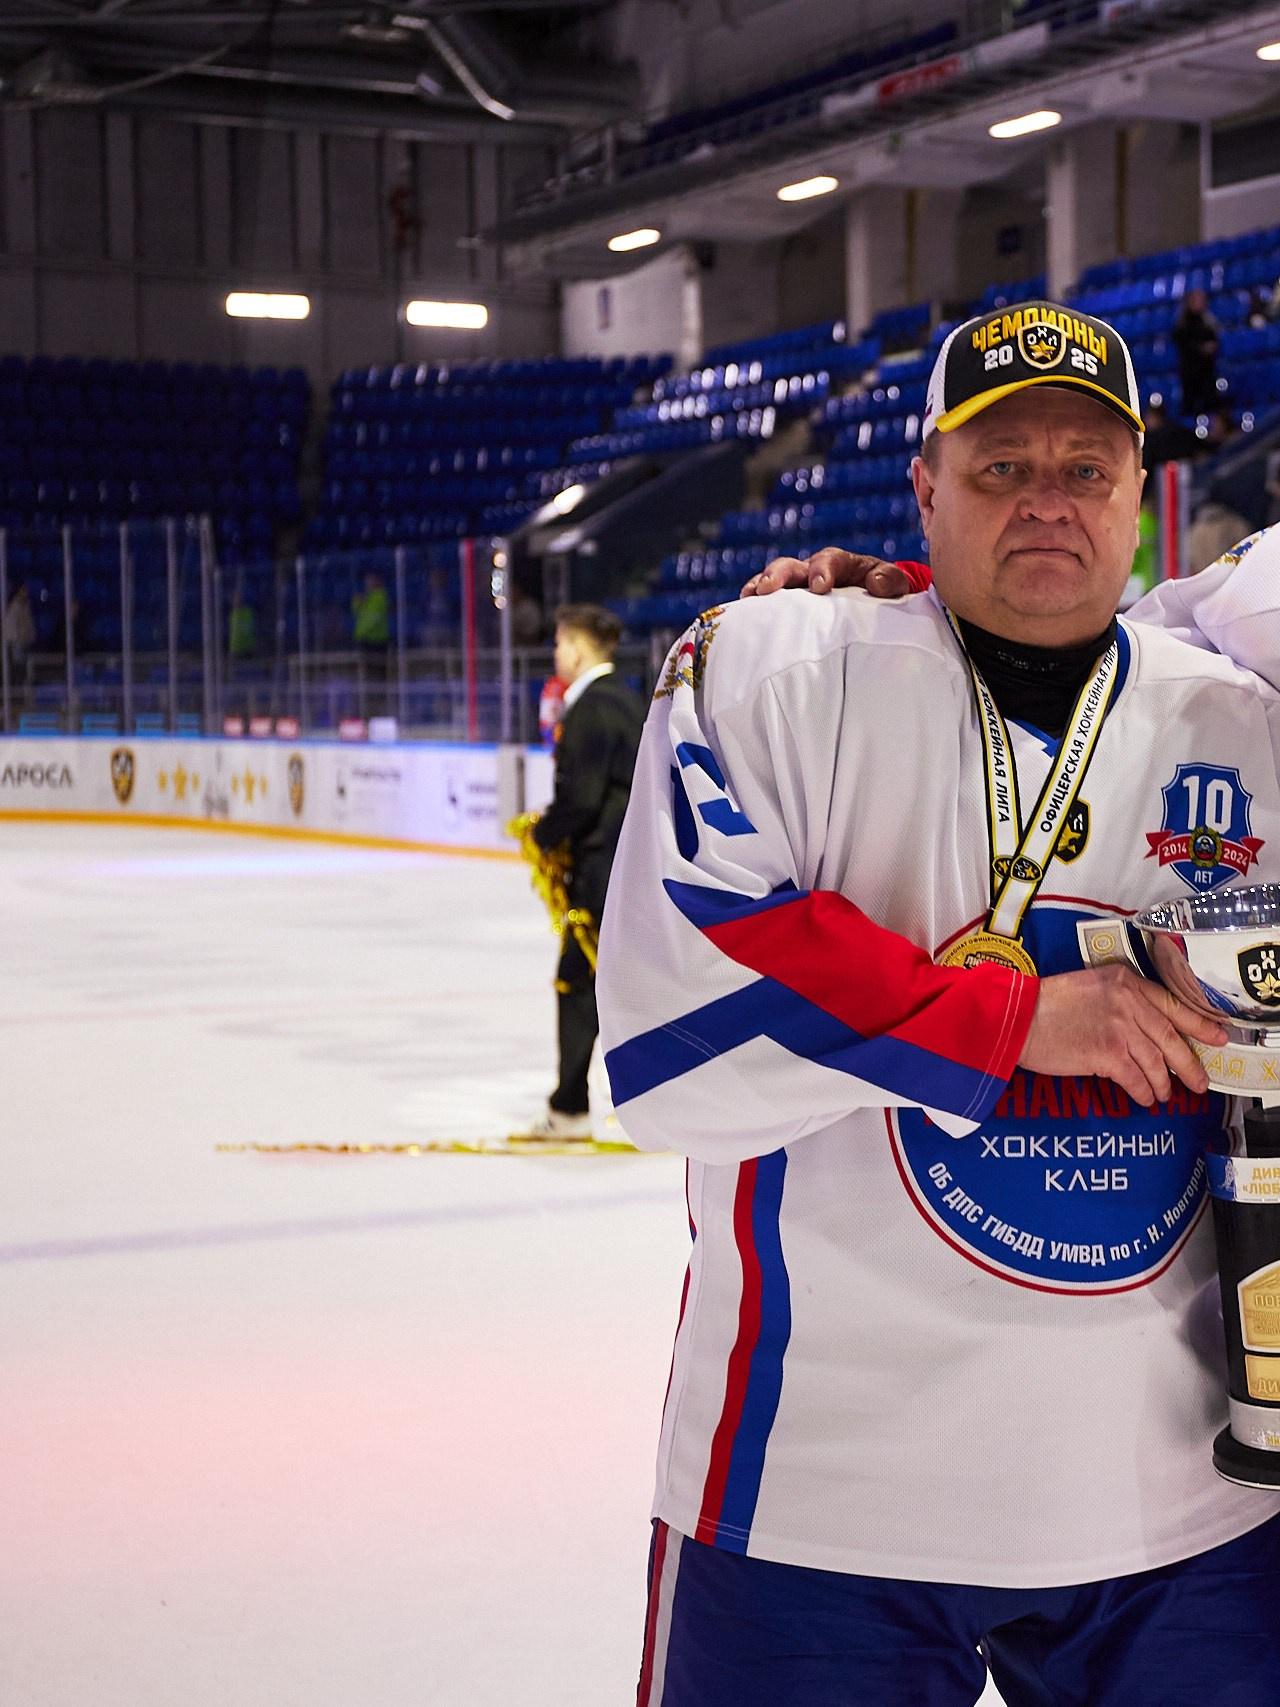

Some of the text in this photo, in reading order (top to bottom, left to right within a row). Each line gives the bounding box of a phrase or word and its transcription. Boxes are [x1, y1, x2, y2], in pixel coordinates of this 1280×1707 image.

[972, 307, 1107, 366] ЧЕМПИОНЫ
[984, 345, 1098, 376] 20 25
[980, 689, 1006, 778] ХОККЕЙНАЯ
[996, 781, 1010, 822] ЛИГА
[1040, 740, 1085, 832] ОФИЦЕРСКАЯ
[1076, 668, 1108, 738] ХОККЕЙНАЯ
[1182, 775, 1233, 834] 10
[1162, 842, 1248, 866] 2014 2024
[1194, 870, 1213, 884] ЛЕТ
[980, 1130, 1176, 1158] ХОККЕЙНЫЙ
[1045, 1168, 1128, 1191] КЛУБ
[928, 1162, 951, 1190] ОБ
[942, 1186, 984, 1223] ДПС
[981, 1214, 1044, 1260] ГИБДД
[1050, 1241, 1106, 1267] УМВД
[1110, 1243, 1131, 1261] по
[1147, 1224, 1164, 1245] Н.
[1162, 1156, 1206, 1230] Новгород
